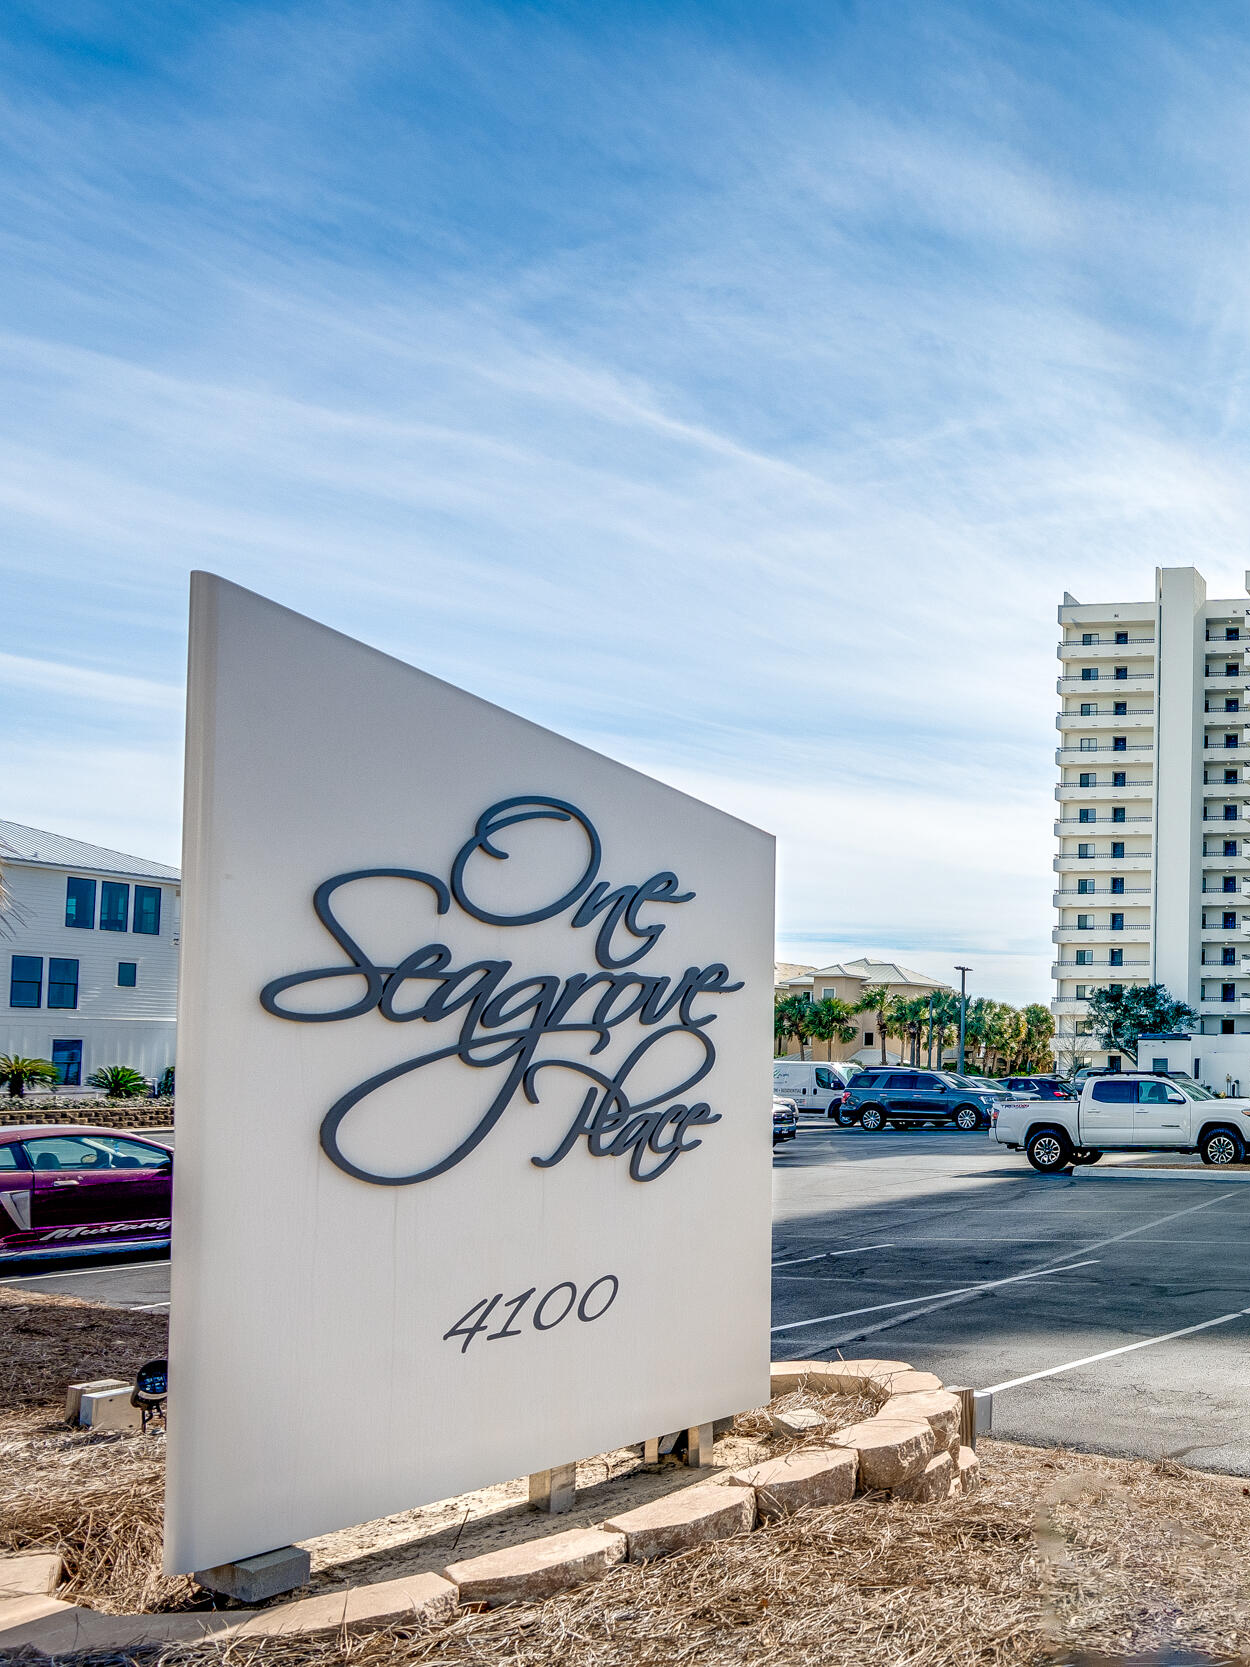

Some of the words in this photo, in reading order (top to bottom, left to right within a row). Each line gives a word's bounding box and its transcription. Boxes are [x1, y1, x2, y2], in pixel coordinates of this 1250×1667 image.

[450, 795, 696, 969] One
[260, 868, 745, 1187] Seagrove
[523, 1025, 722, 1183] Place
[40, 1220, 171, 1241] Mustang
[442, 1274, 619, 1354] 4100
